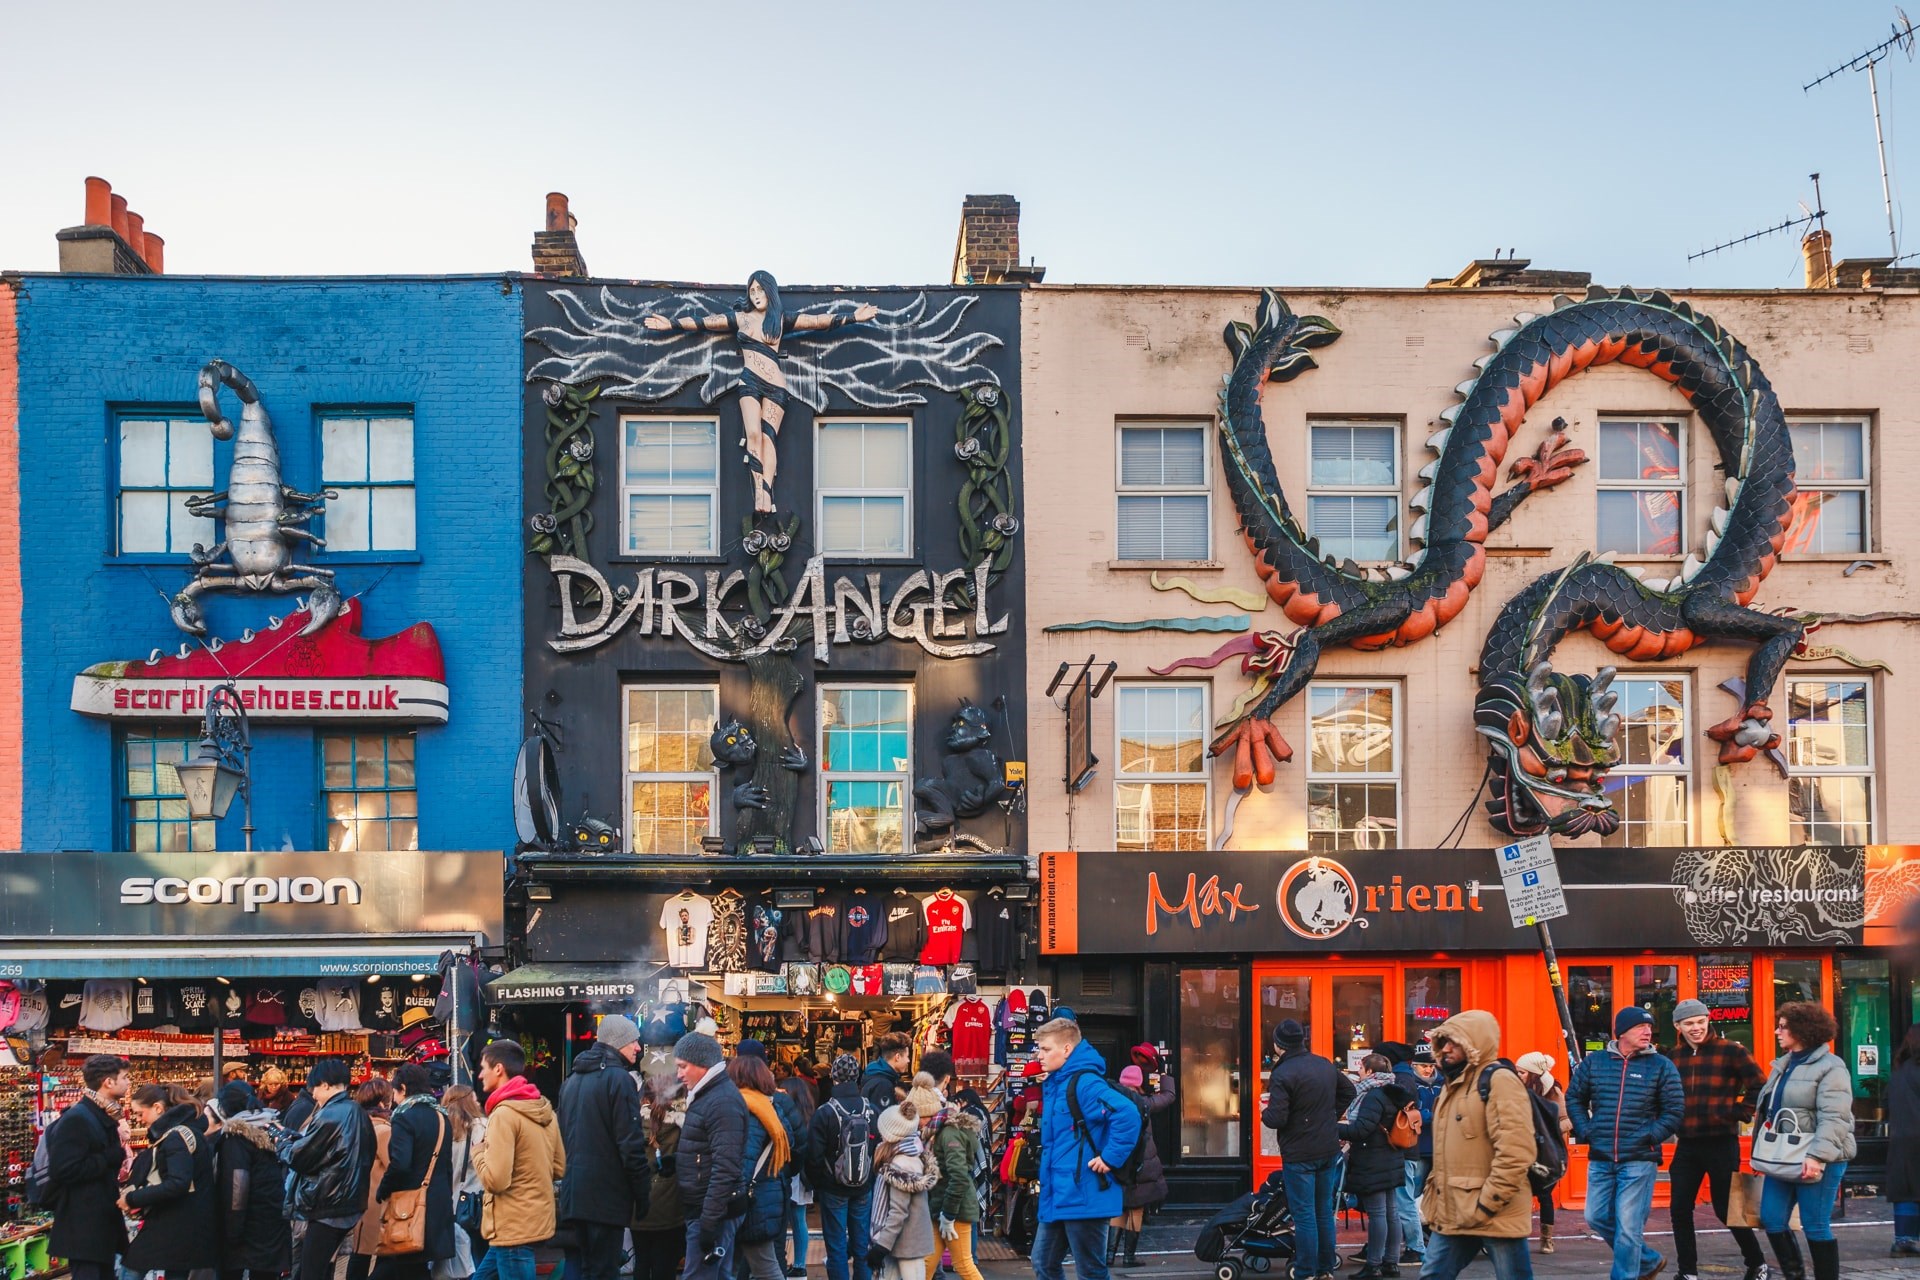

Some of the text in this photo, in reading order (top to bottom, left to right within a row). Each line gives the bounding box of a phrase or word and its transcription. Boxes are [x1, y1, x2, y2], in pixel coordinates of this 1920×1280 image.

[547, 552, 1009, 664] DARK ANGEL
[1520, 840, 1541, 849] Loading
[121, 877, 361, 913] scorpion
[1509, 894, 1533, 903] Midnight
[1537, 892, 1561, 901] Midnight
[1752, 885, 1859, 903] restaurant
[1046, 855, 1056, 949] www.maxorient.co.uk
[1146, 871, 1260, 935] Max
[932, 924, 957, 934] Emirates
[0, 965, 23, 976] 269
[956, 967, 972, 975] NIKE
[1702, 968, 1749, 979] CHINESE
[1702, 979, 1733, 989] FOOD
[498, 984, 635, 999] FLASHING T-SHIRTS
[405, 996, 436, 1007] QUEEN
[1415, 1007, 1450, 1019] OPEN
[1708, 1008, 1750, 1020] KEAWAY
